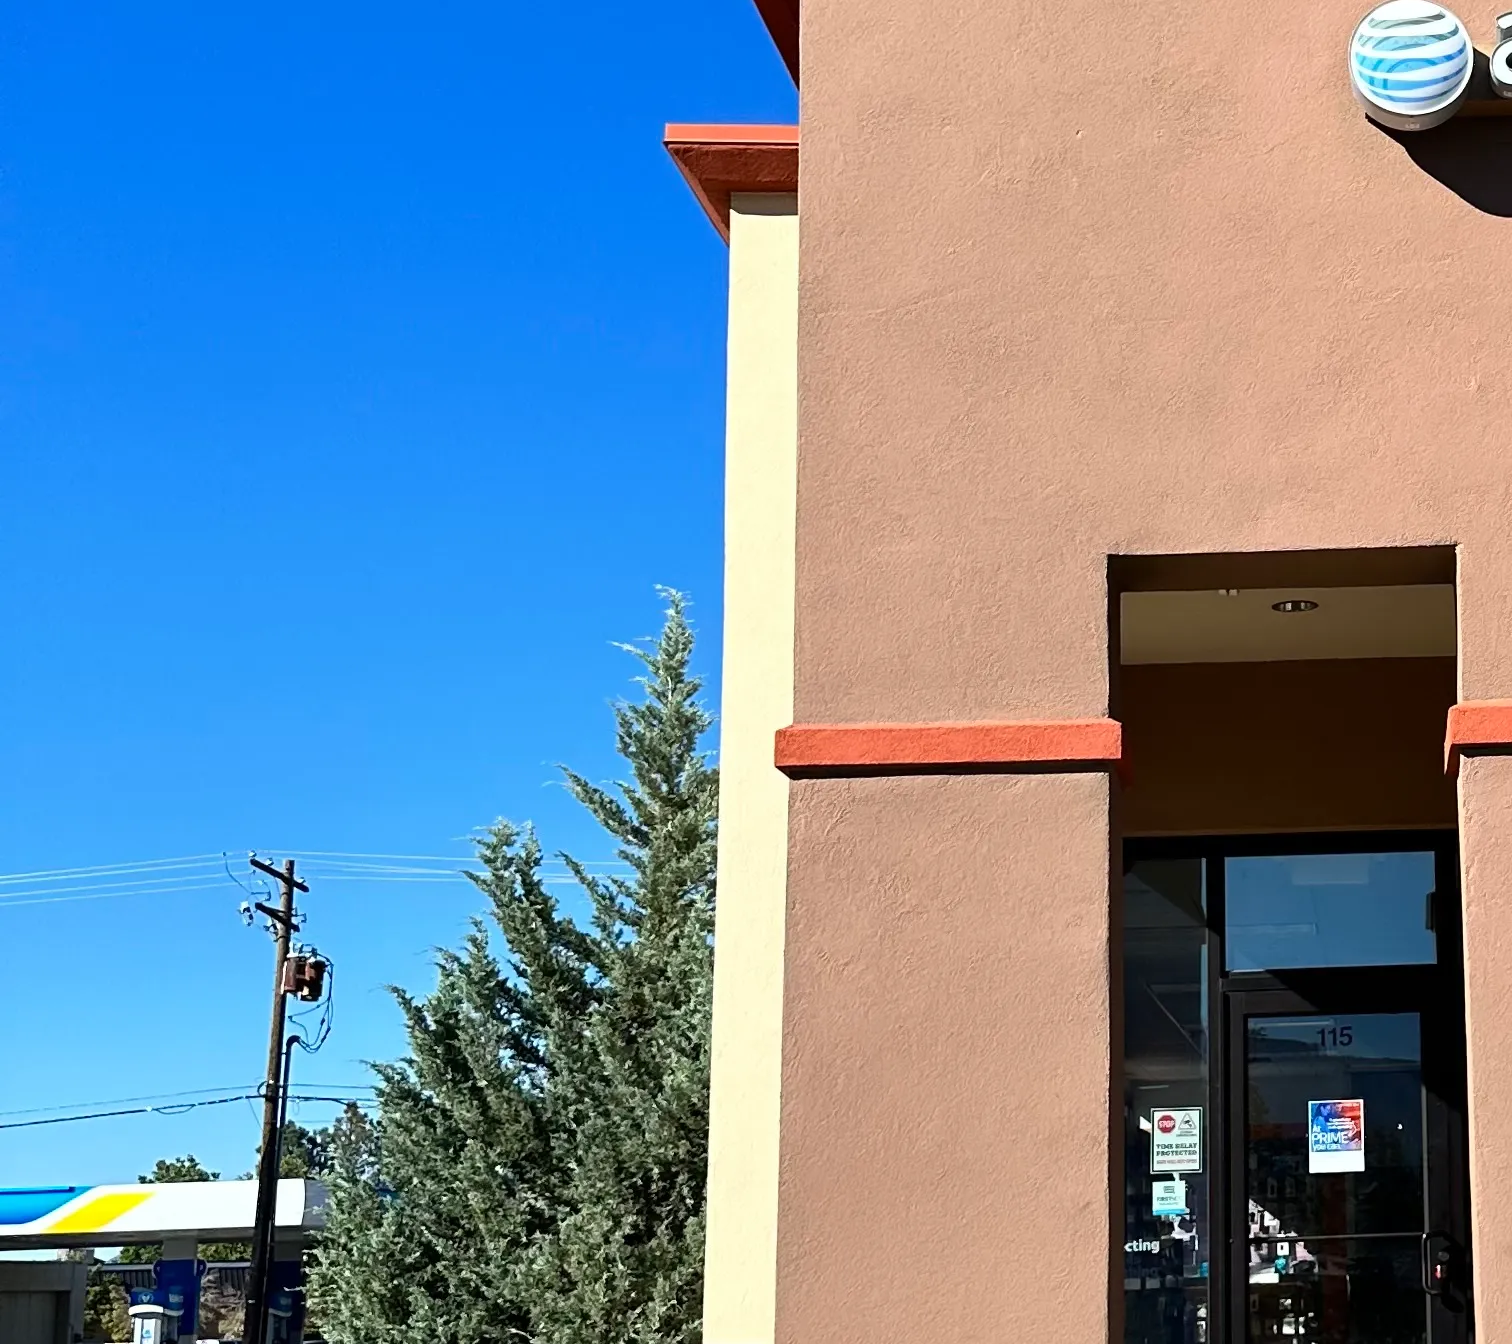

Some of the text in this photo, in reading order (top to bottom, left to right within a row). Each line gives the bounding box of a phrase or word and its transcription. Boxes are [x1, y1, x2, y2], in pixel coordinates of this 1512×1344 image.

[1317, 1026, 1353, 1047] 115
[1158, 1120, 1175, 1129] STOP
[1312, 1132, 1349, 1144] PRIME
[1313, 1144, 1327, 1152] you
